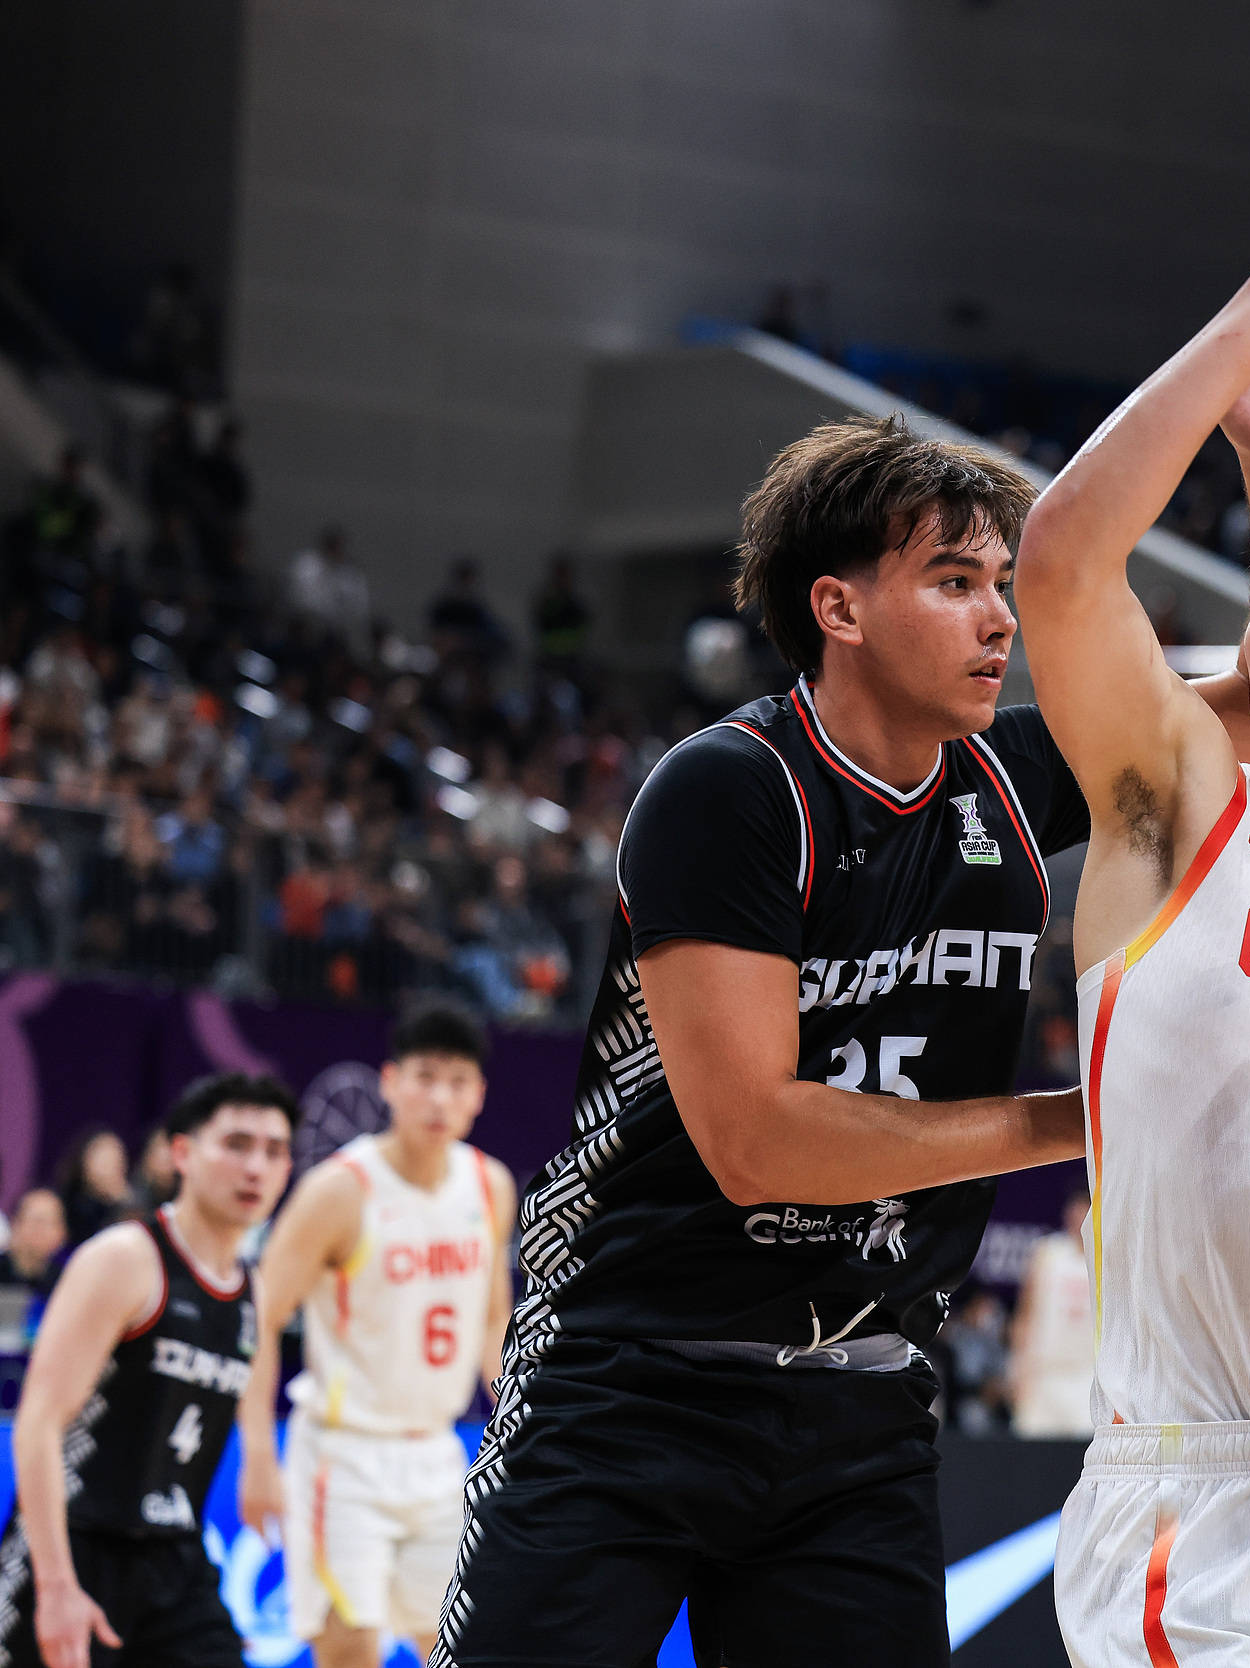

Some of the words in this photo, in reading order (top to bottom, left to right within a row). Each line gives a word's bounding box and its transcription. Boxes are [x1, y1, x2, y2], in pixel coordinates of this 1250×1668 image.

[961, 841, 981, 851] ASIA
[981, 841, 996, 851] CUP
[782, 1207, 835, 1232] Bank
[837, 1217, 865, 1233] of
[423, 1304, 459, 1369] 6
[167, 1402, 203, 1465] 4
